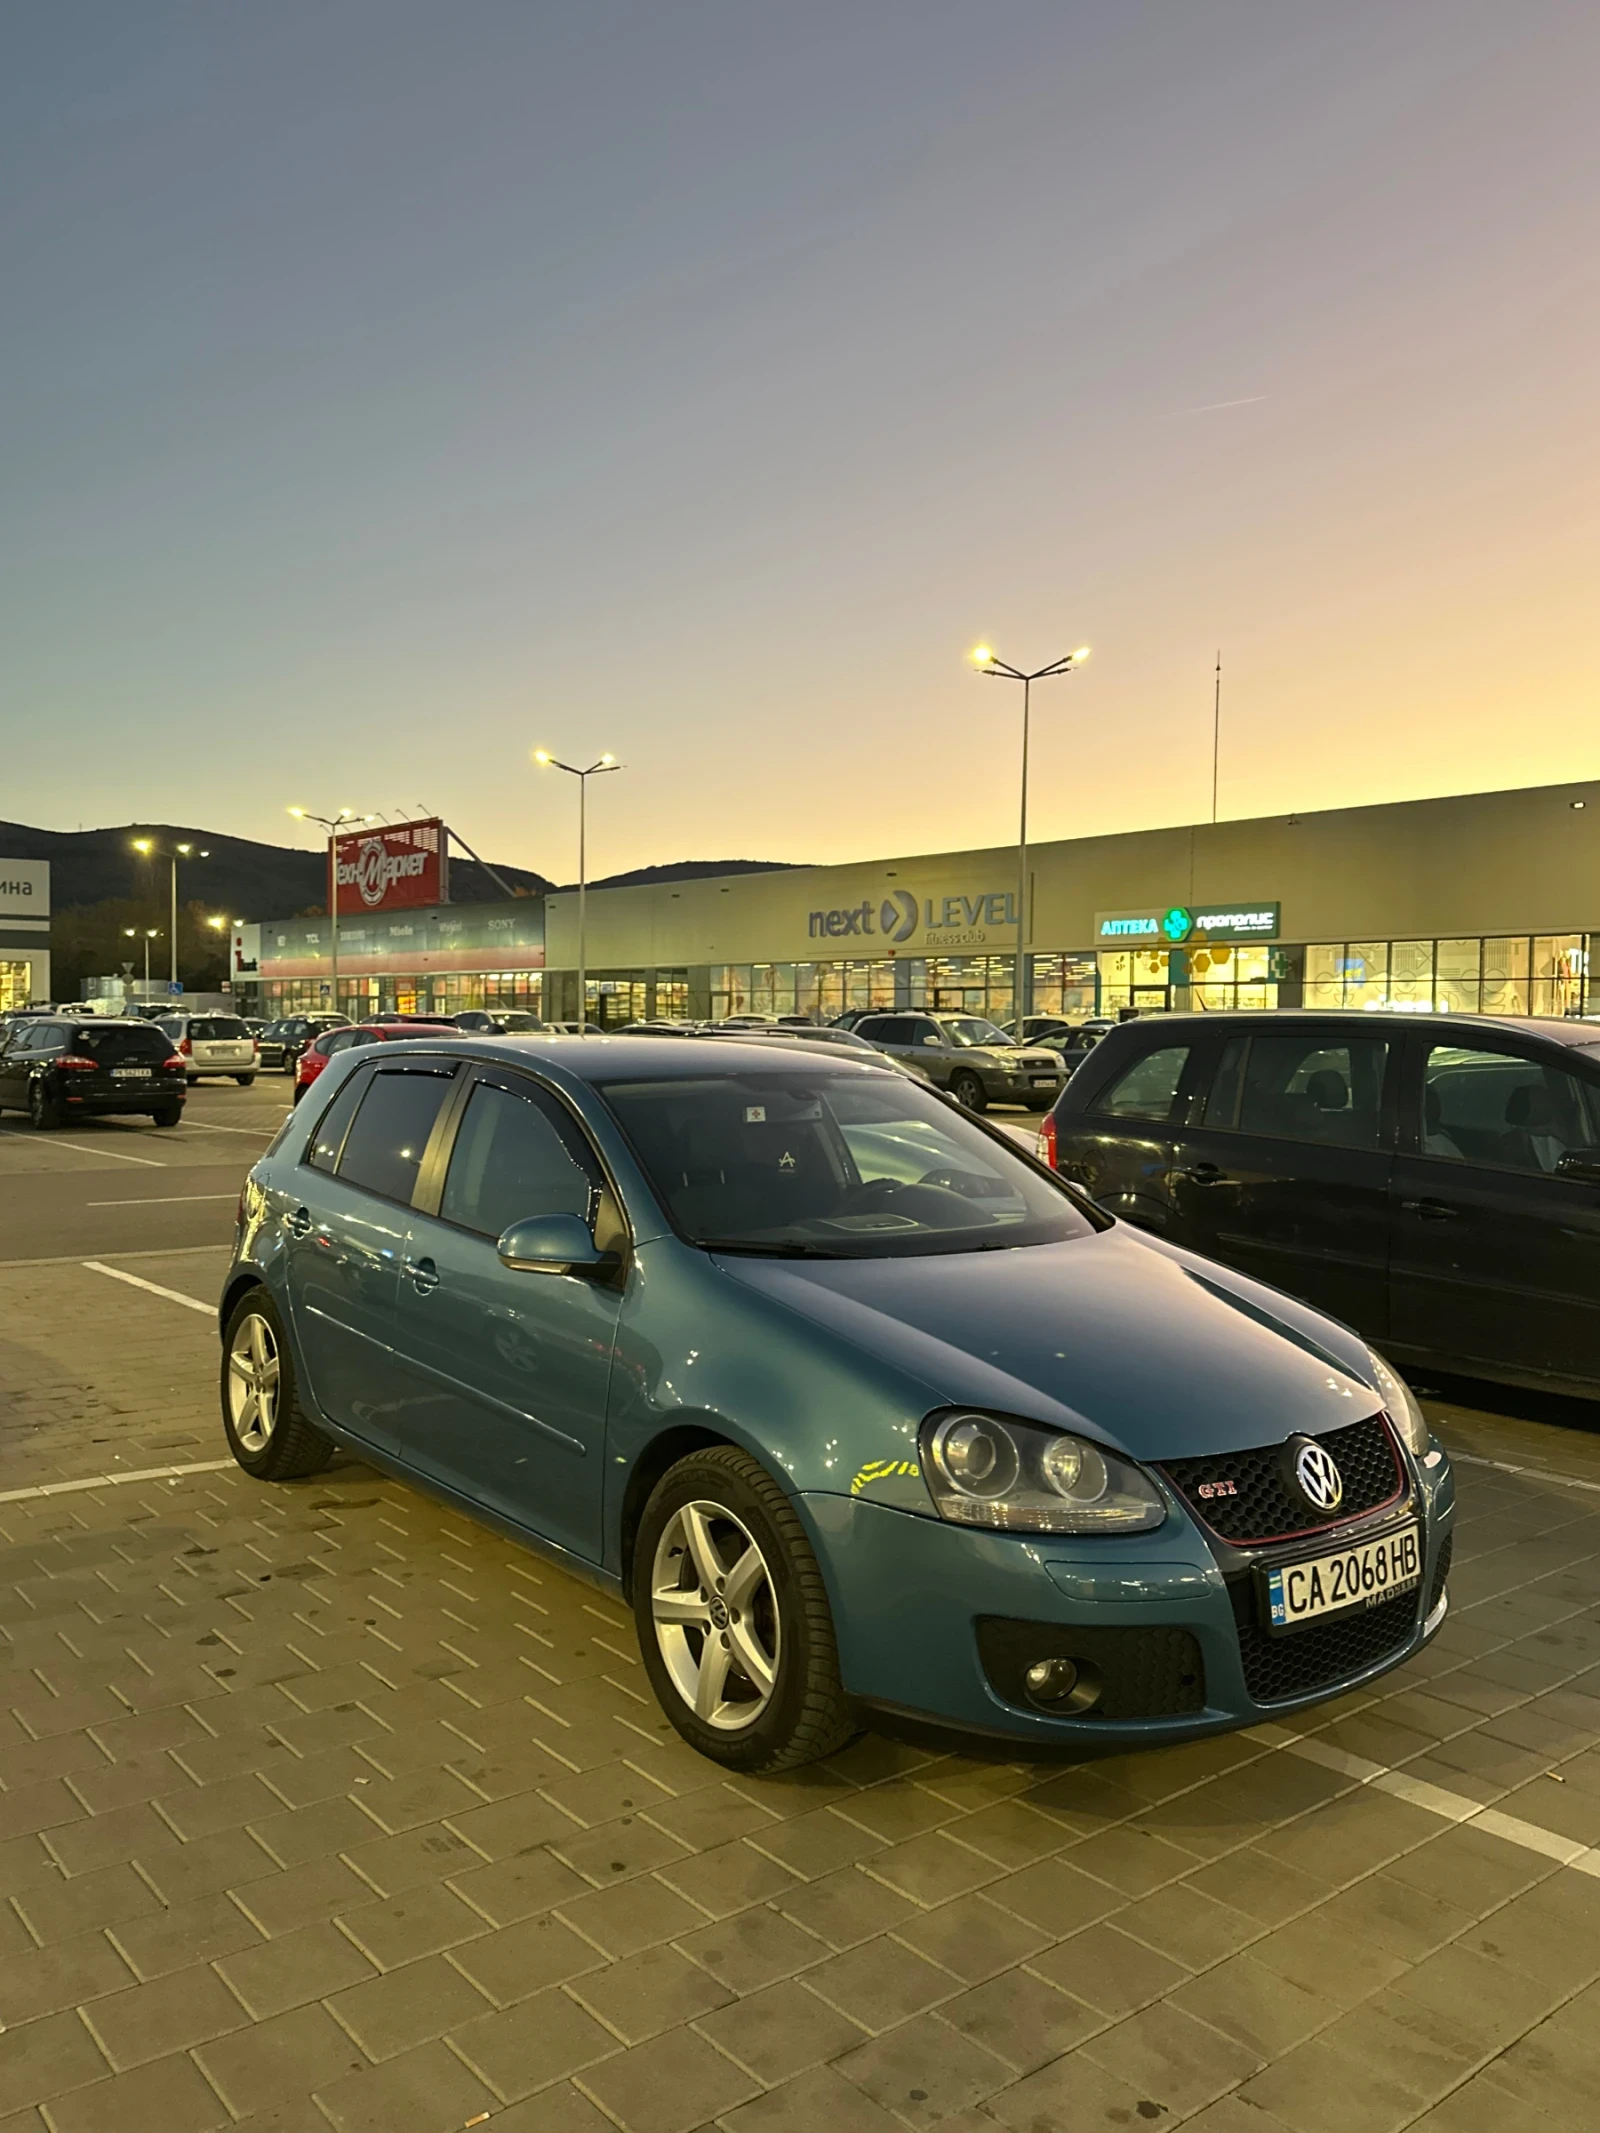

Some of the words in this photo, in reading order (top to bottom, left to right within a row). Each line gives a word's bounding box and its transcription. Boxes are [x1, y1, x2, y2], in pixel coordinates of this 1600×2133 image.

[809, 901, 875, 938] next
[924, 893, 1019, 928] LEVEL
[488, 918, 515, 930] SONY
[1101, 919, 1158, 935] АПТЕКА
[925, 932, 960, 945] fitness
[961, 930, 985, 943] club
[1198, 1480, 1238, 1499] GTI
[1271, 1603, 1285, 1618] BG
